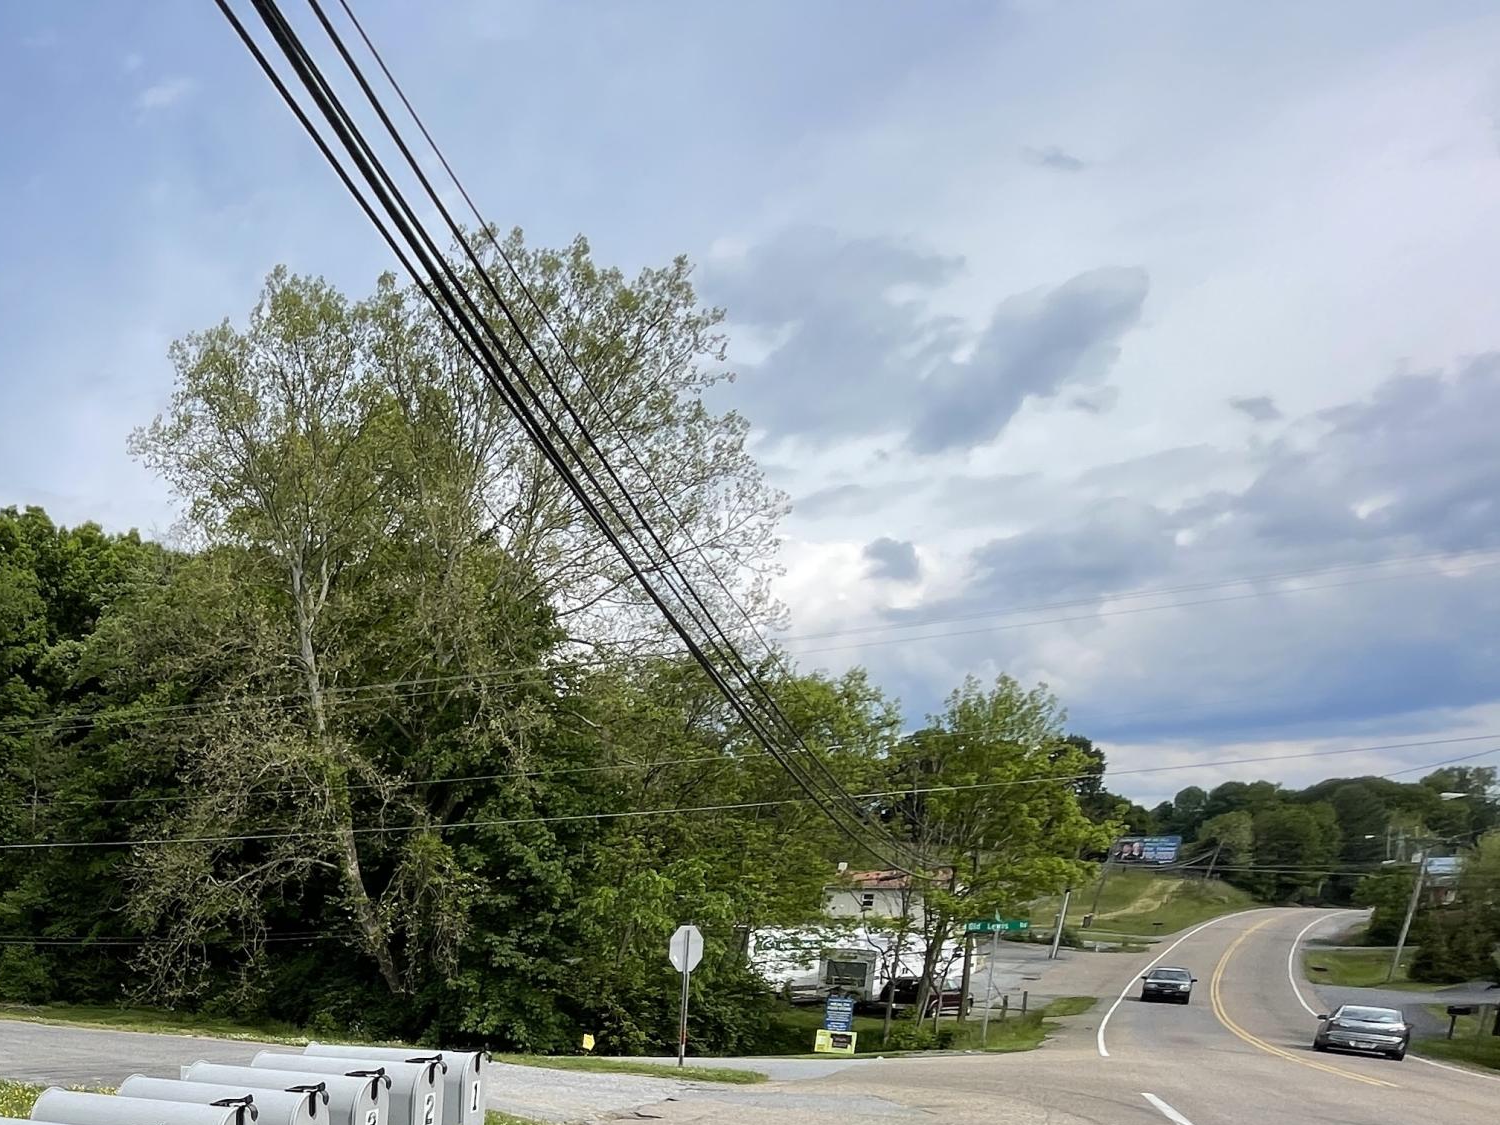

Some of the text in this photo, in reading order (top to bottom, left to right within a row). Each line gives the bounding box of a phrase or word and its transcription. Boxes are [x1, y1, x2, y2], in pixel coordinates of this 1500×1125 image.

[968, 922, 981, 930] Old
[987, 922, 1009, 930] Lewis
[424, 1095, 435, 1125] 2
